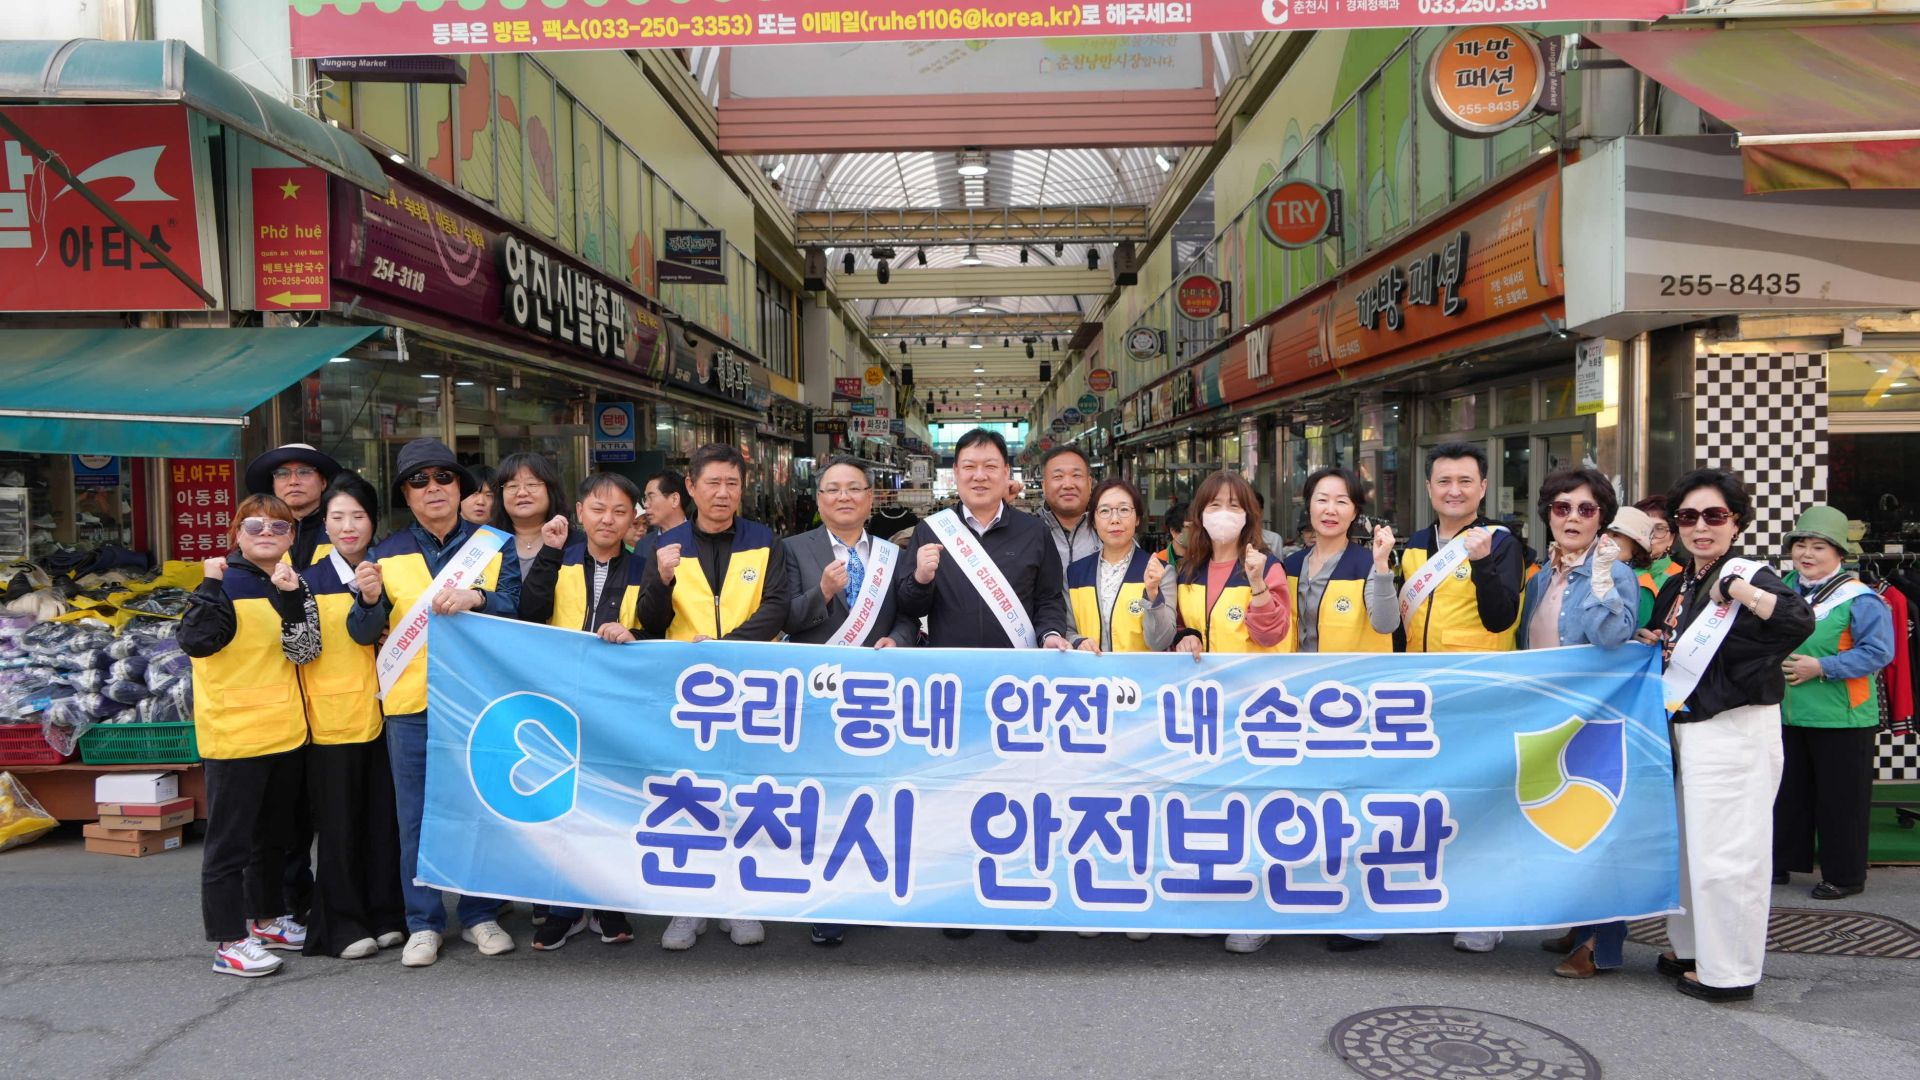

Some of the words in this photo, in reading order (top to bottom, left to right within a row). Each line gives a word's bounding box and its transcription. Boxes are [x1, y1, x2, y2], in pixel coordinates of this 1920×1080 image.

[1293, 0, 1328, 14] 춘천시
[1346, 0, 1400, 12] 경제정책과
[432, 23, 488, 44] 등록은
[493, 20, 538, 45] 방문,
[542, 14, 753, 41] 팩스(033-250-3353)
[758, 14, 796, 34] 또는
[802, 5, 1101, 34] 이메일(ruhe1106@korea.kr)로
[1106, 3, 1192, 25] 해주세요!
[1455, 37, 1515, 60] 까망
[1549, 42, 1557, 79] Jungang
[321, 58, 357, 69] Jungang
[358, 58, 387, 68] Market
[1455, 65, 1514, 96] 패션
[1550, 79, 1558, 106] Market
[1458, 101, 1520, 116] 255-8435
[1272, 199, 1320, 225] TRY
[260, 225, 288, 239] Phở
[295, 224, 322, 240] huệ
[59, 225, 172, 272] 아티스
[262, 262, 324, 273] 베트남쌀국수
[372, 256, 426, 293] 254-3118
[1660, 273, 1801, 297] 255-8435
[1245, 325, 1270, 379] TRY
[603, 414, 626, 426] 담배
[867, 419, 889, 430] 화장실
[177, 489, 230, 506] 아동화
[178, 512, 231, 528] 숙녀화
[179, 534, 231, 550] 운동화
[976, 566, 1019, 623] 안전점검의
[390, 608, 430, 662] 전점검의
[676, 668, 799, 752] 우리
[1163, 684, 1219, 755] 내
[1242, 685, 1435, 758] 손으로
[636, 776, 915, 898] 춘천시
[970, 792, 1453, 907] 안전보안관
